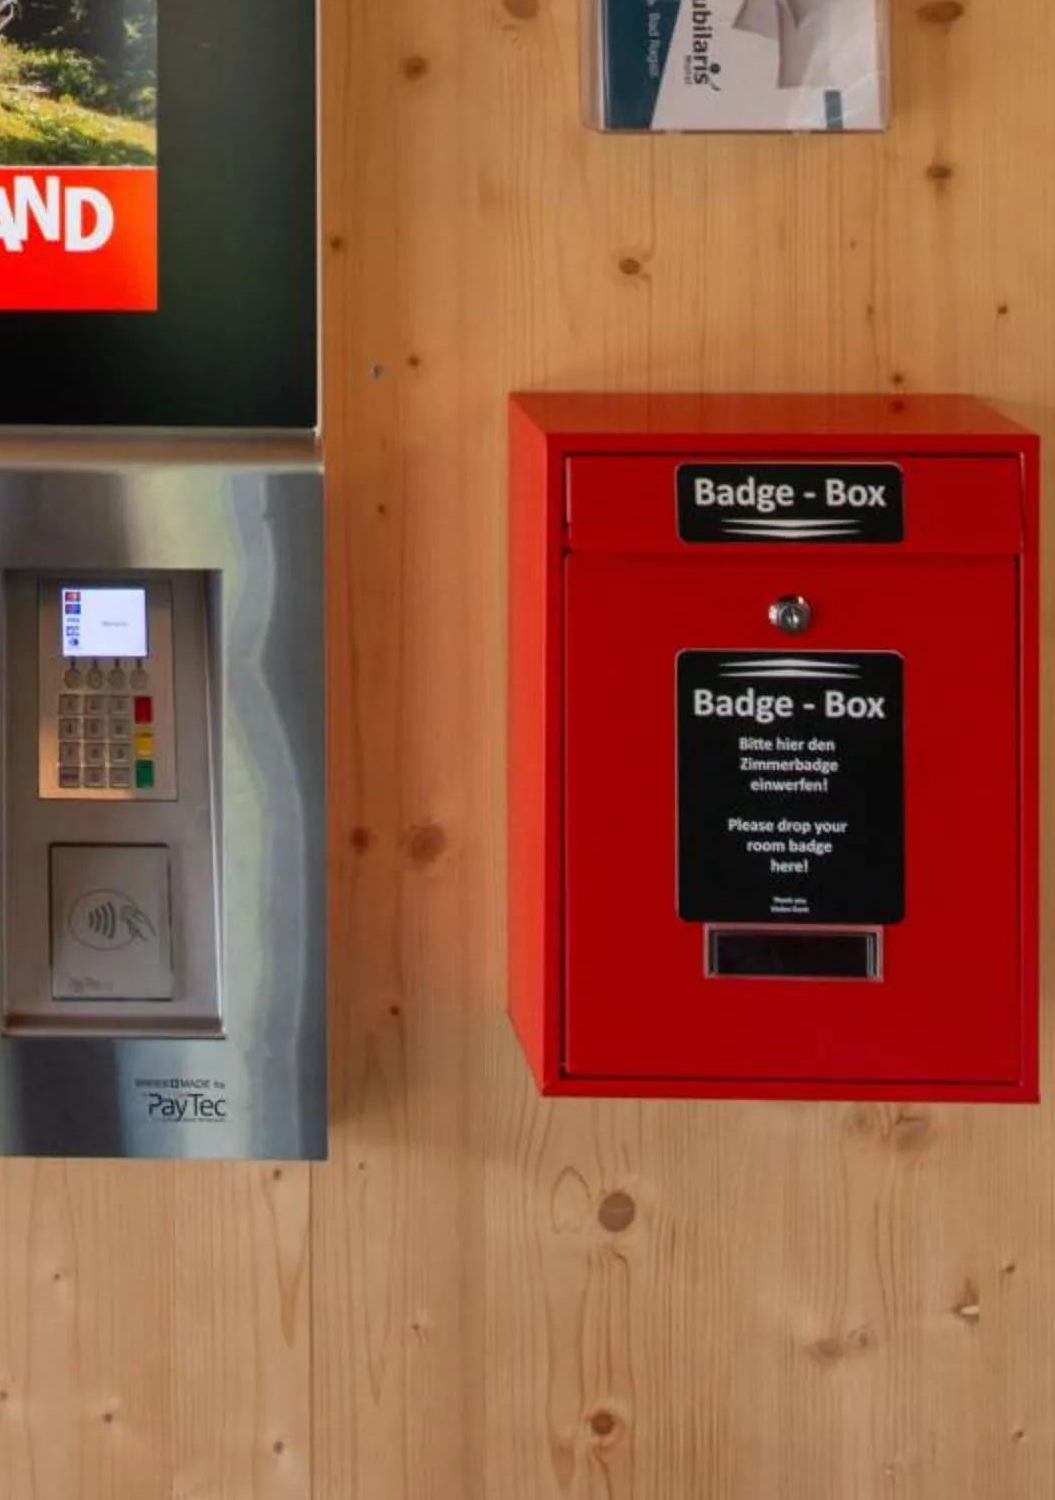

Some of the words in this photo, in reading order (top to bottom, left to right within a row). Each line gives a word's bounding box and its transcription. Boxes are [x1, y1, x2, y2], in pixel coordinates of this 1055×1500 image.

[693, 476, 795, 513] Badge
[825, 478, 887, 507] Box
[693, 688, 794, 725] Badge
[824, 690, 886, 719] Box
[738, 737, 774, 752] Bitte
[776, 737, 804, 752] hier
[808, 737, 836, 752] den
[740, 757, 839, 774] Zimmerbadge
[750, 777, 829, 793] einwerfen!
[728, 818, 774, 833] Please
[777, 818, 811, 836] drop
[814, 821, 848, 836] your
[746, 841, 786, 852] room
[789, 838, 833, 855] badge
[770, 858, 809, 873] here!
[148, 1092, 227, 1122] PayTec
